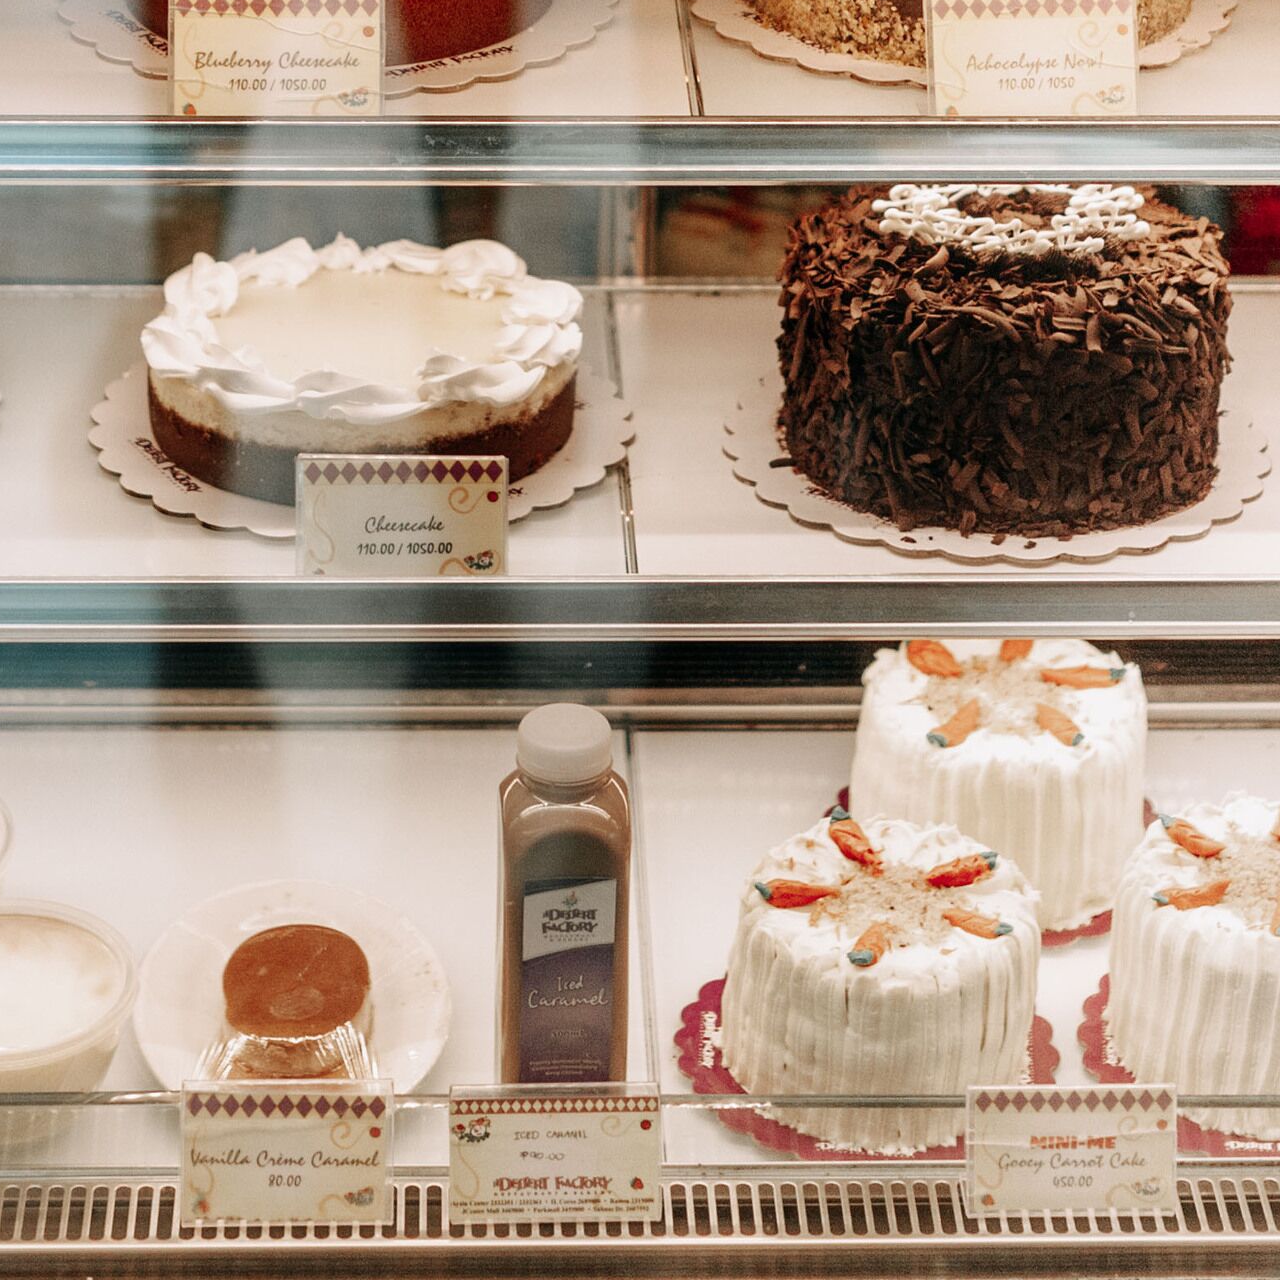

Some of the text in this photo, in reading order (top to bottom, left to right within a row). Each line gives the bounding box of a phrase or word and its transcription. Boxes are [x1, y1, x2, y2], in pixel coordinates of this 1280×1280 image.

[194, 50, 360, 74] Blueberry Cheesecake
[229, 78, 267, 91] 110.00
[280, 78, 327, 91] 1050.00
[998, 78, 1036, 90] 110.00
[1048, 77, 1076, 89] 1050
[364, 515, 446, 534] Cheesecake
[356, 543, 395, 556] 110.00
[406, 542, 453, 555] 1050.00
[557, 975, 584, 992] Iced
[527, 988, 609, 1009] Caramel
[1030, 1135, 1118, 1150] MINI-ME
[190, 1148, 251, 1168] Vanilla
[311, 1150, 381, 1168] Caramel
[998, 1152, 1146, 1174] Gooey Carrot Cake
[268, 1174, 302, 1188] 80.00
[1052, 1175, 1093, 1188] 450.00
